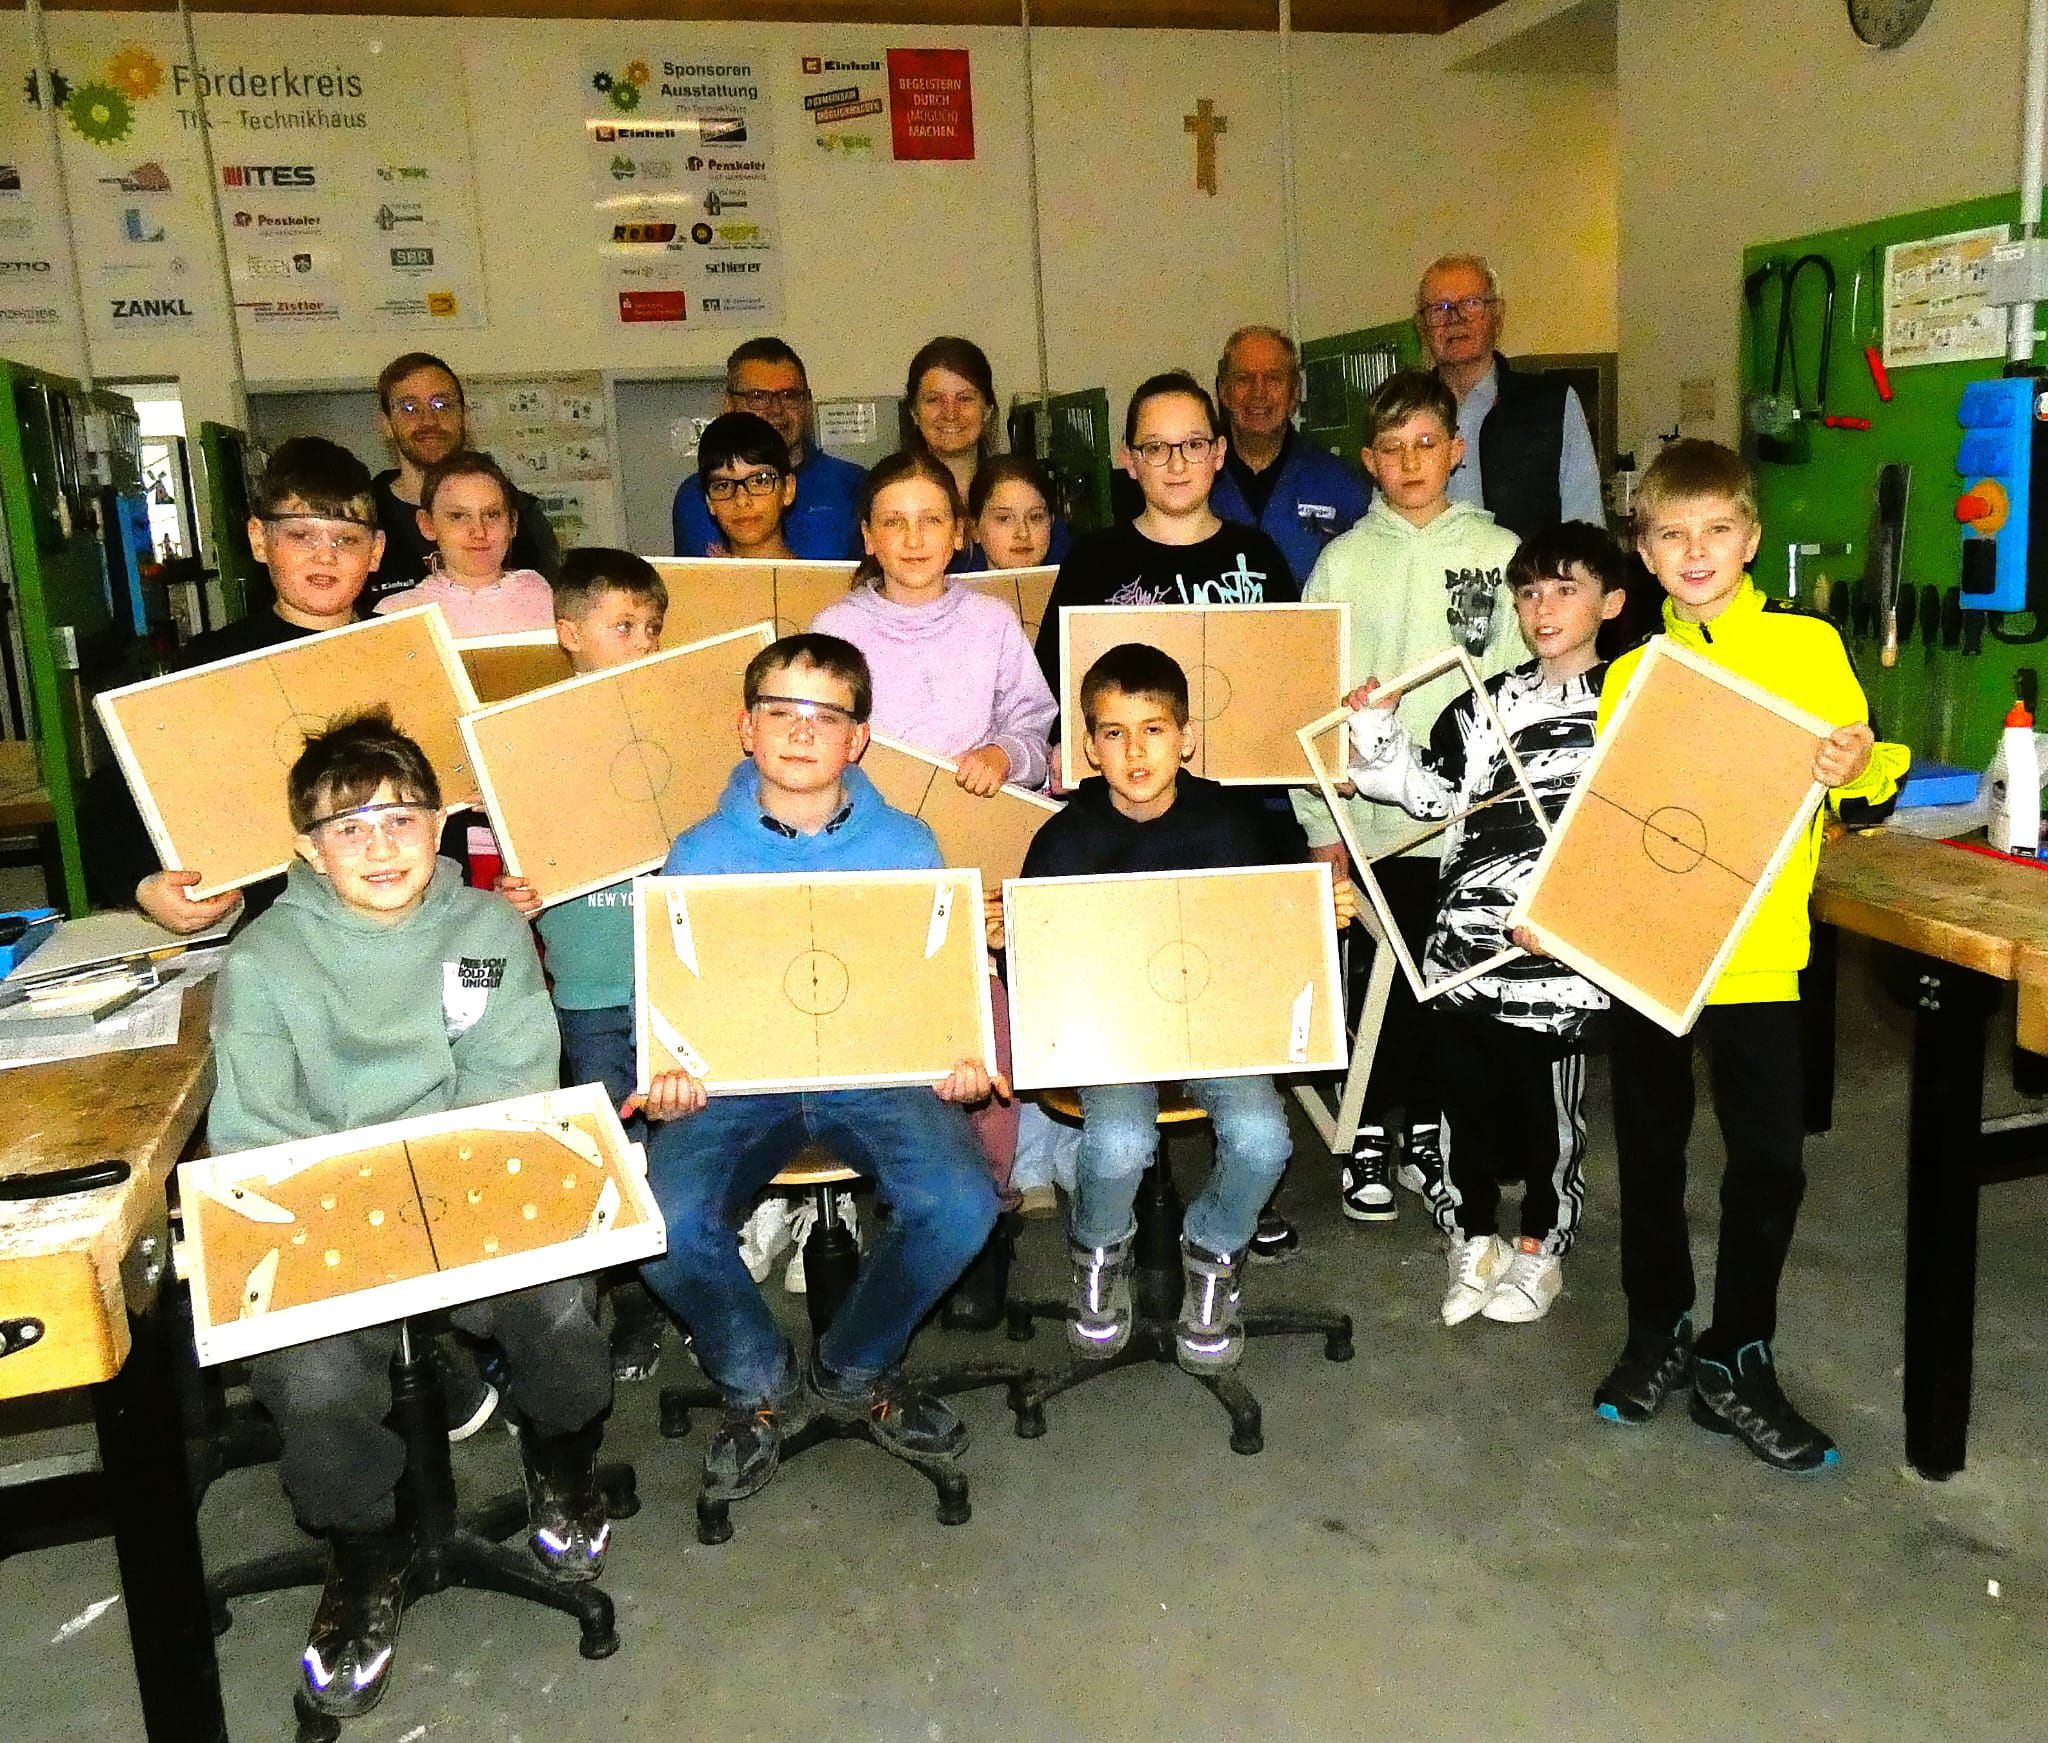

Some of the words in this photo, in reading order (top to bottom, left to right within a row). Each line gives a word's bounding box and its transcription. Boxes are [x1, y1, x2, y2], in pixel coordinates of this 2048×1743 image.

[663, 62, 751, 79] Sponsoren
[172, 65, 363, 97] Förderkreis
[899, 78, 962, 90] BEGEISTERN
[661, 83, 758, 100] Ausstattung
[913, 95, 950, 106] DURCH
[240, 109, 368, 130] Technikhaus
[111, 300, 193, 318] ZANKL
[588, 892, 616, 907] NEW
[620, 892, 635, 907] YO
